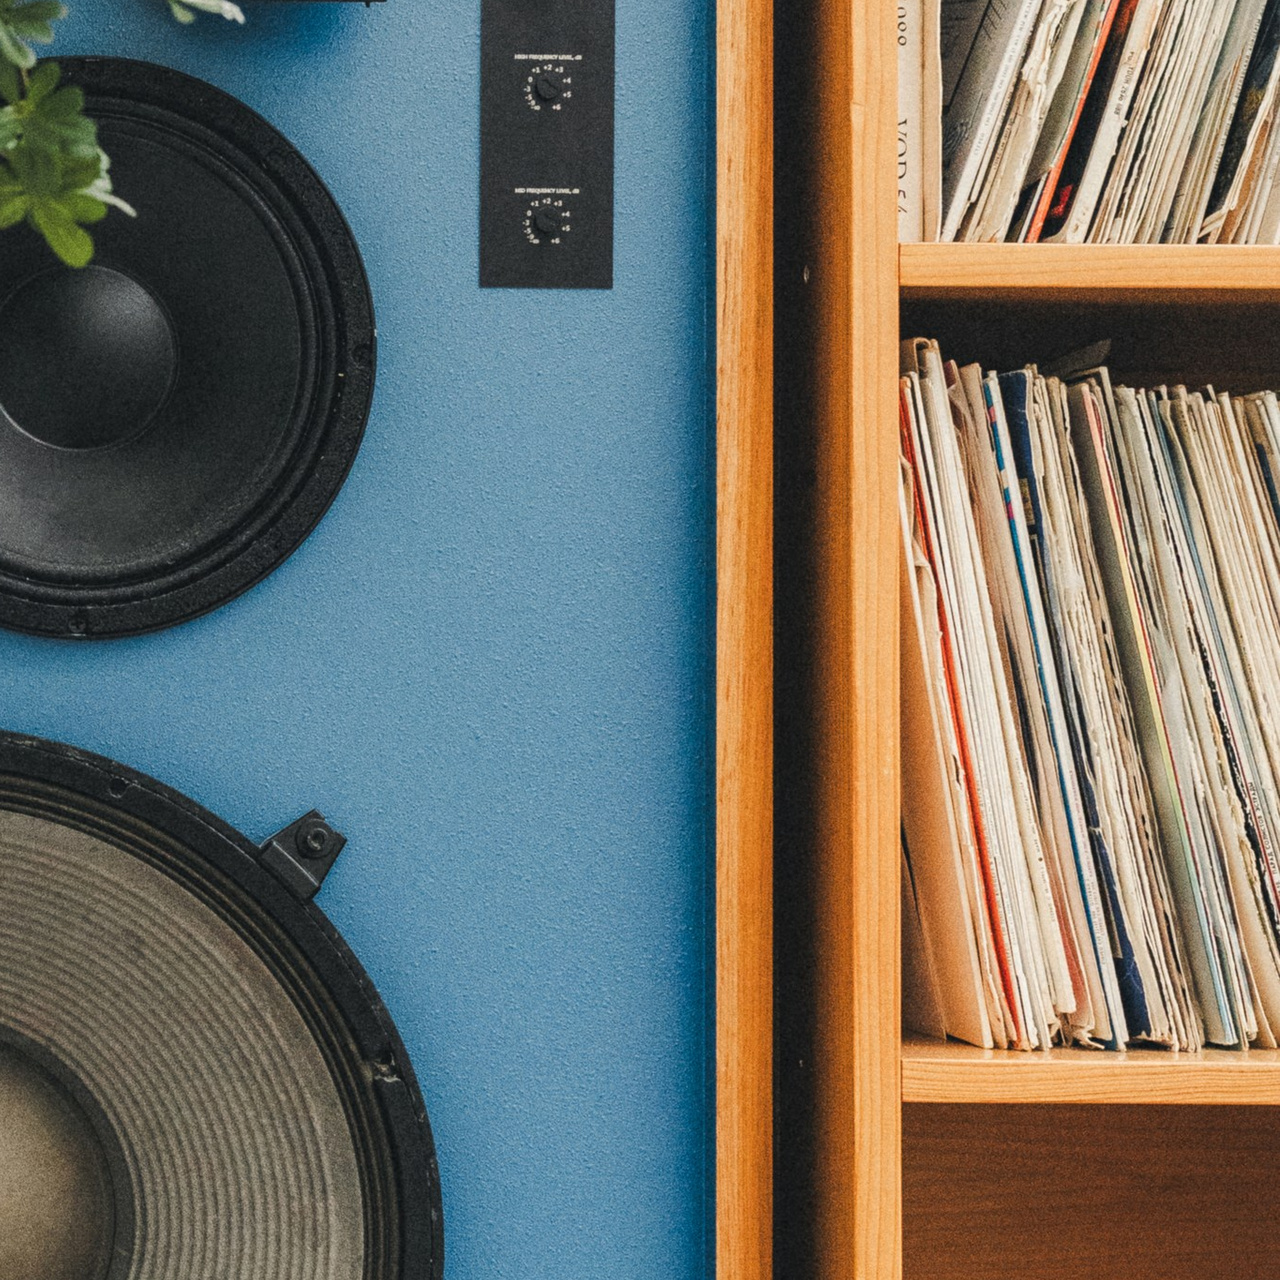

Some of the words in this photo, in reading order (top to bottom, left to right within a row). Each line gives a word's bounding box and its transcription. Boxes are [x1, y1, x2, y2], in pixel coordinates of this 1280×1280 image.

[1247, 780, 1261, 812] ЭСТРАДЫ
[1257, 814, 1271, 850] СОЛИСТОВ
[1266, 849, 1278, 875] ПАРАД
